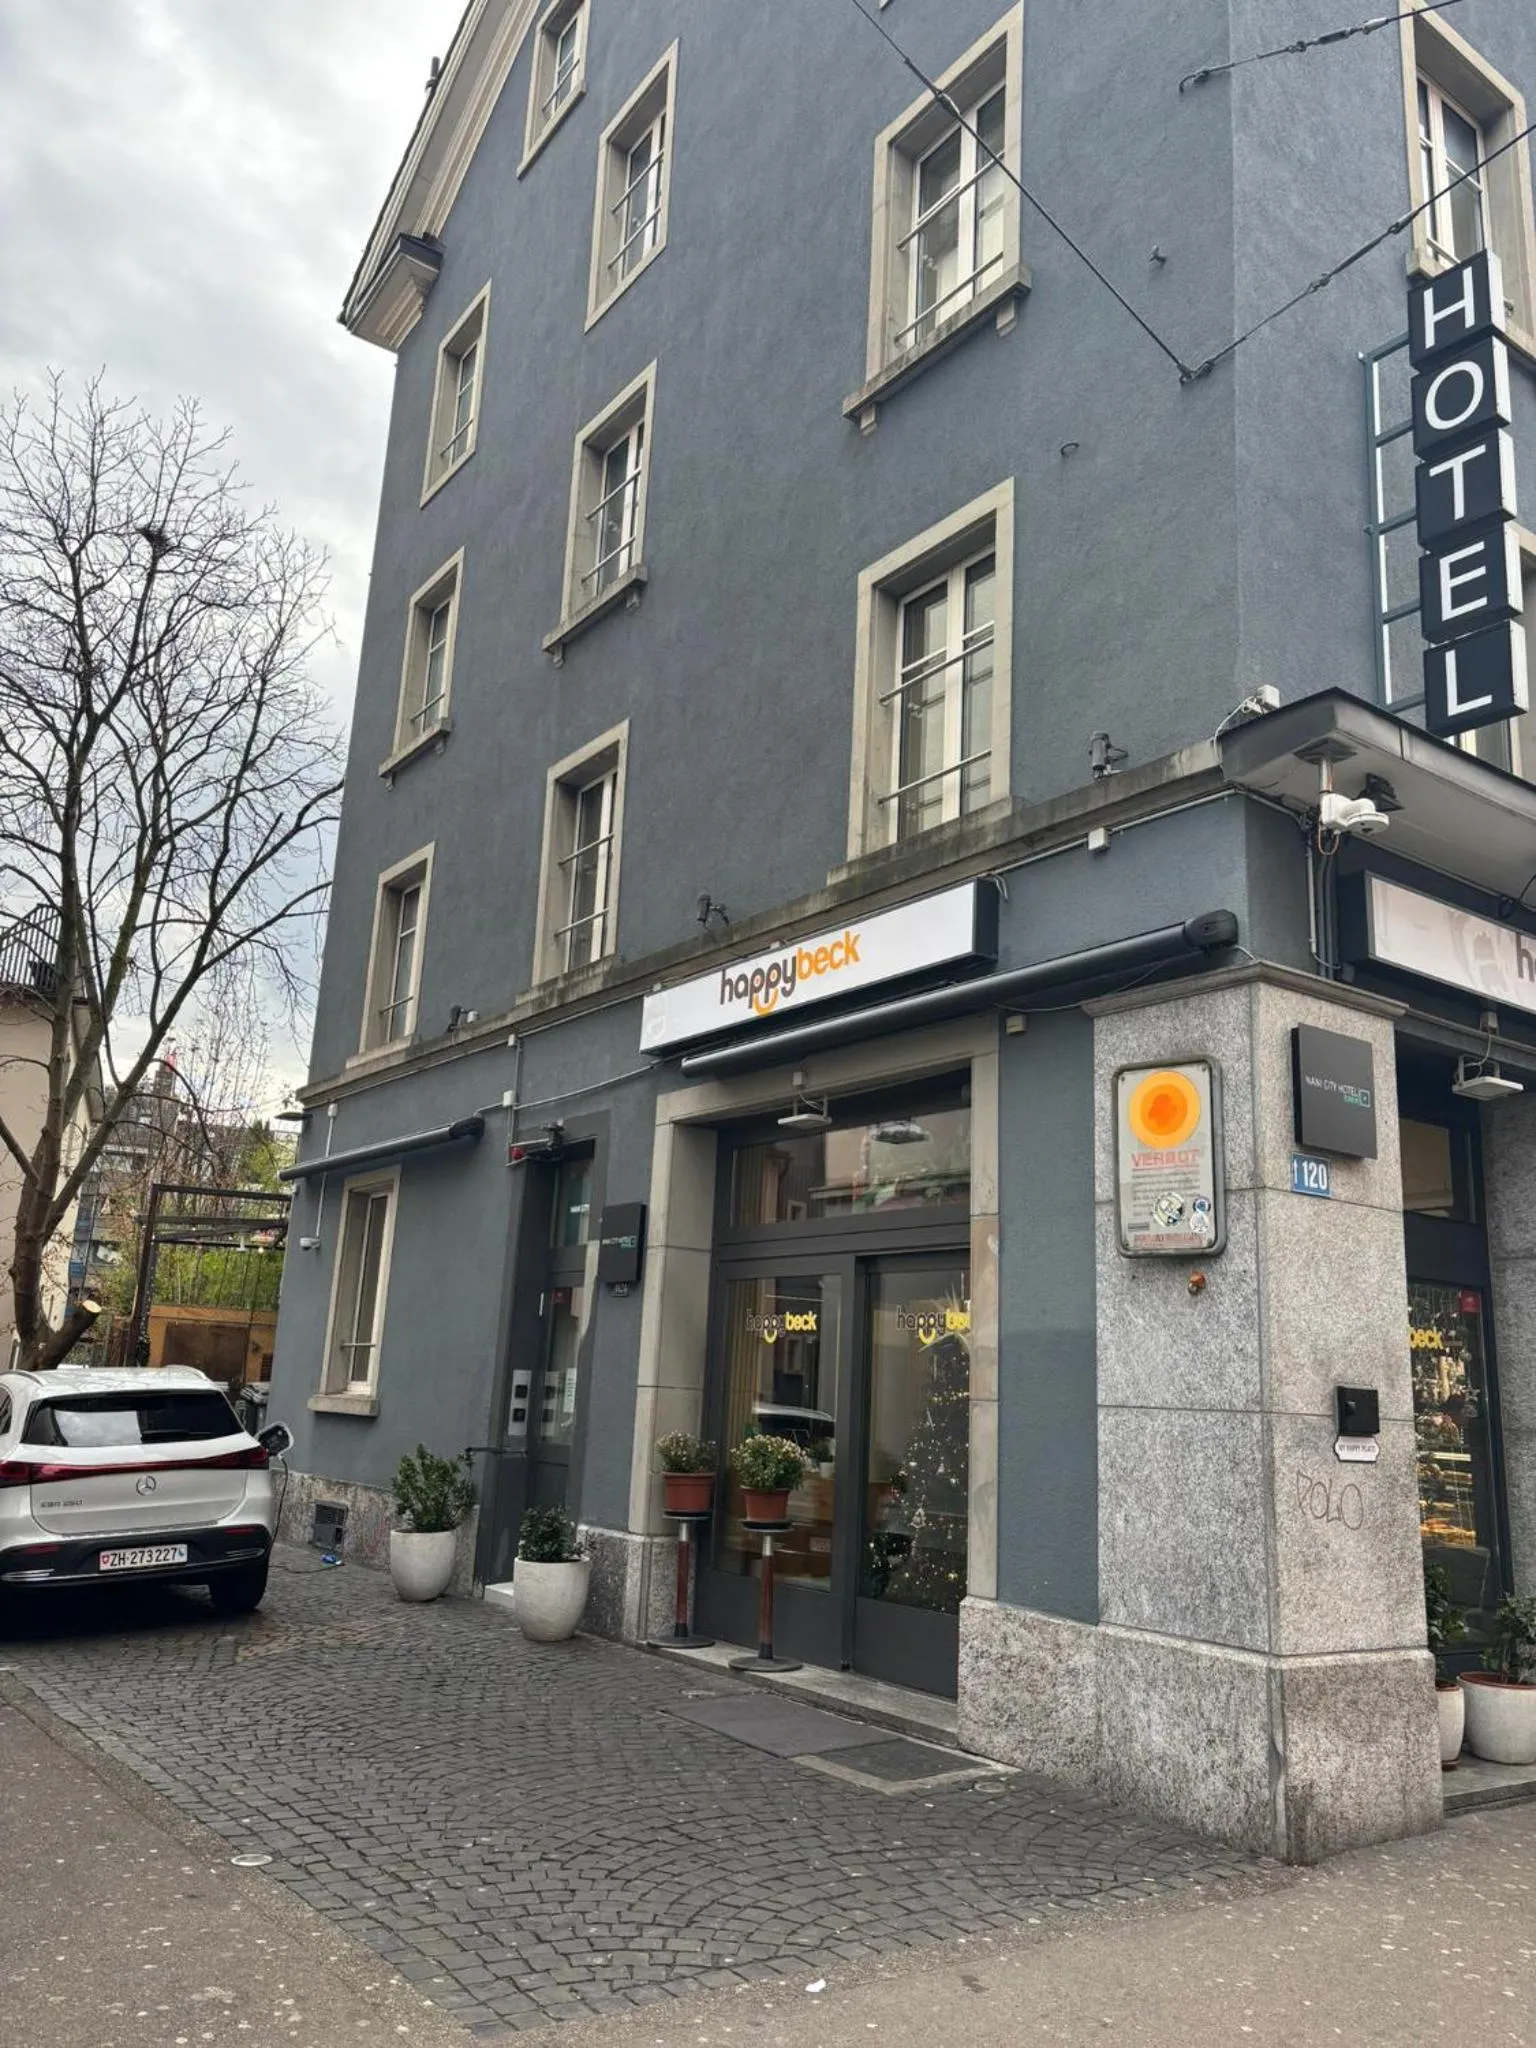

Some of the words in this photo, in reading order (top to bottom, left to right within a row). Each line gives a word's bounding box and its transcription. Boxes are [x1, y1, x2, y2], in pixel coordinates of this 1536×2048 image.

[1424, 266, 1492, 717] HOTEL
[720, 930, 861, 1010] happybeck
[1130, 1148, 1200, 1167] VERBOT
[1302, 1160, 1328, 1190] 120
